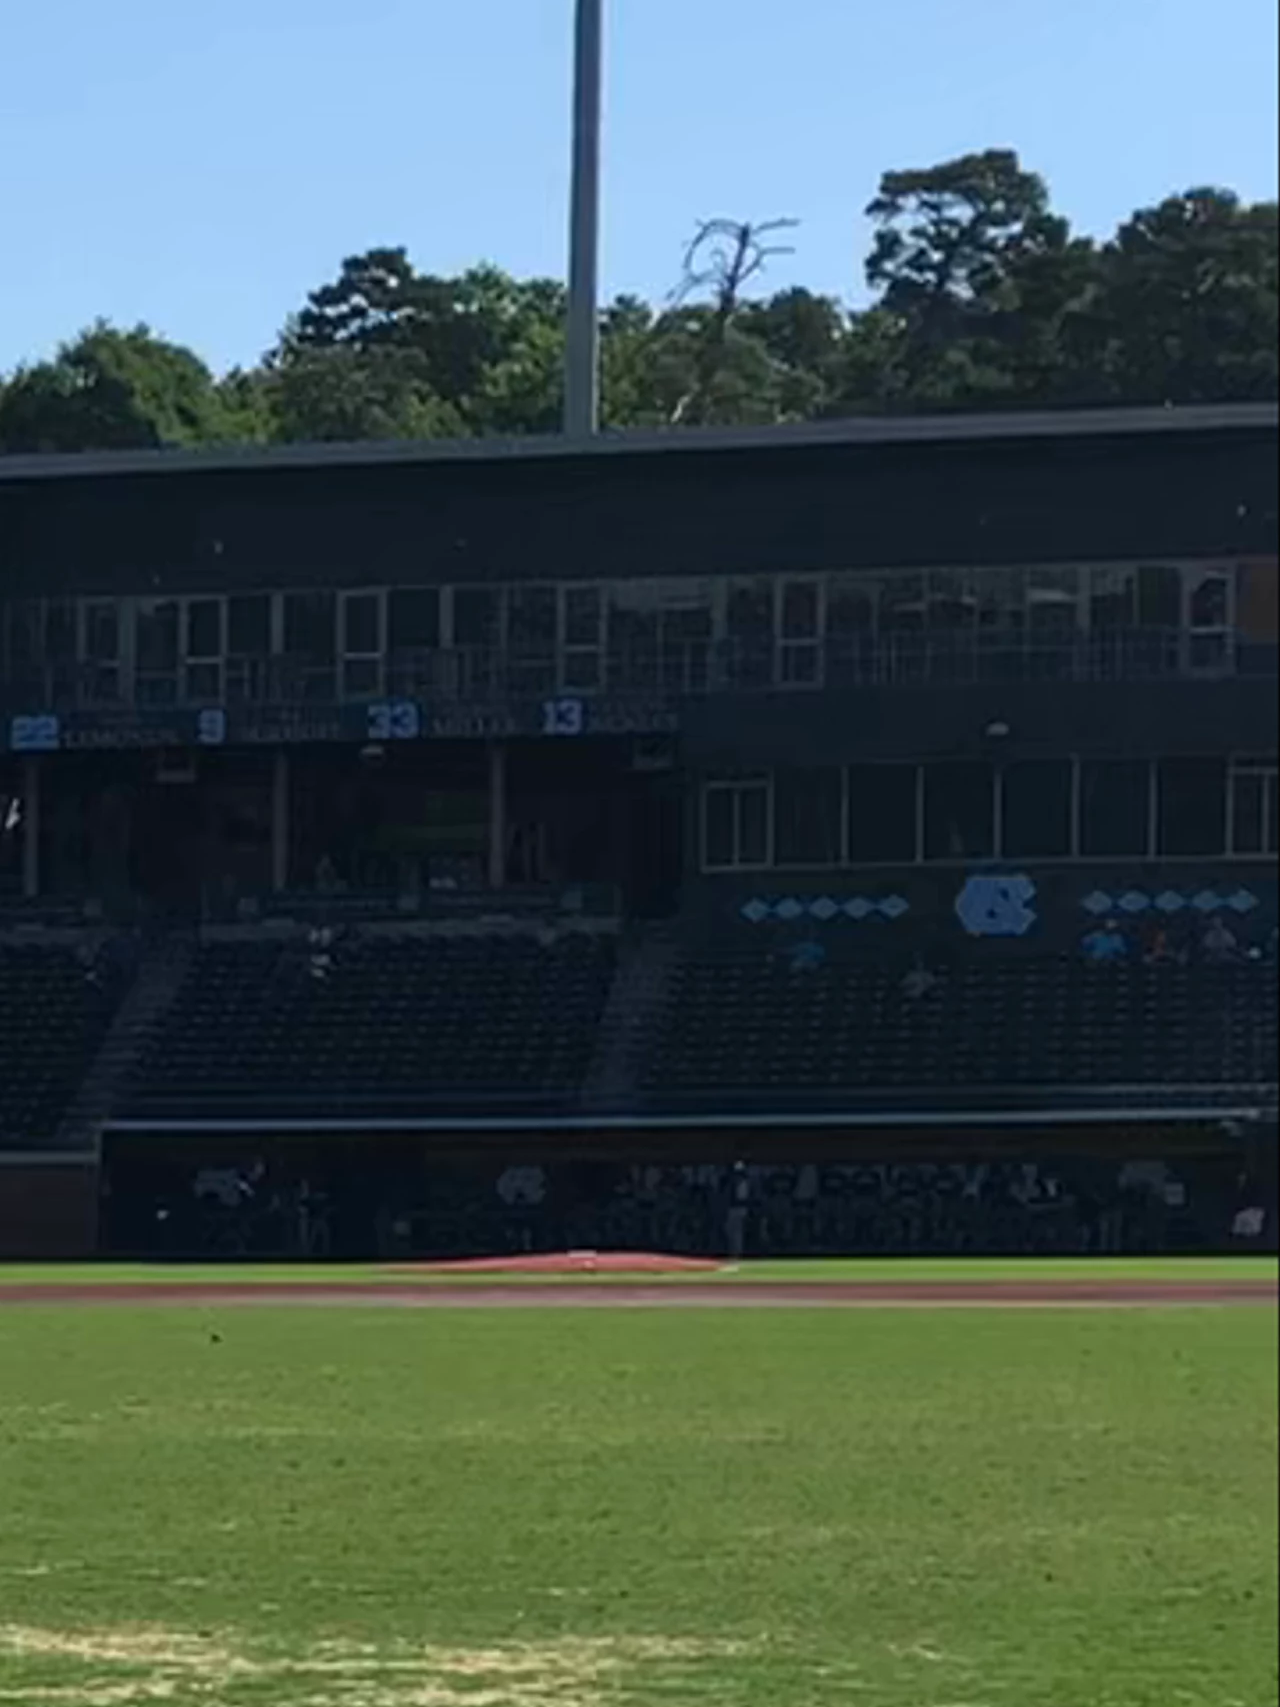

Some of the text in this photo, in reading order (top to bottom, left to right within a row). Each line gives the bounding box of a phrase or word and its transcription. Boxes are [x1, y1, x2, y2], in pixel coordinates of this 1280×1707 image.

[12, 715, 59, 750] 22
[198, 709, 225, 744] 9
[368, 702, 419, 739] 33
[543, 699, 582, 735] 13
